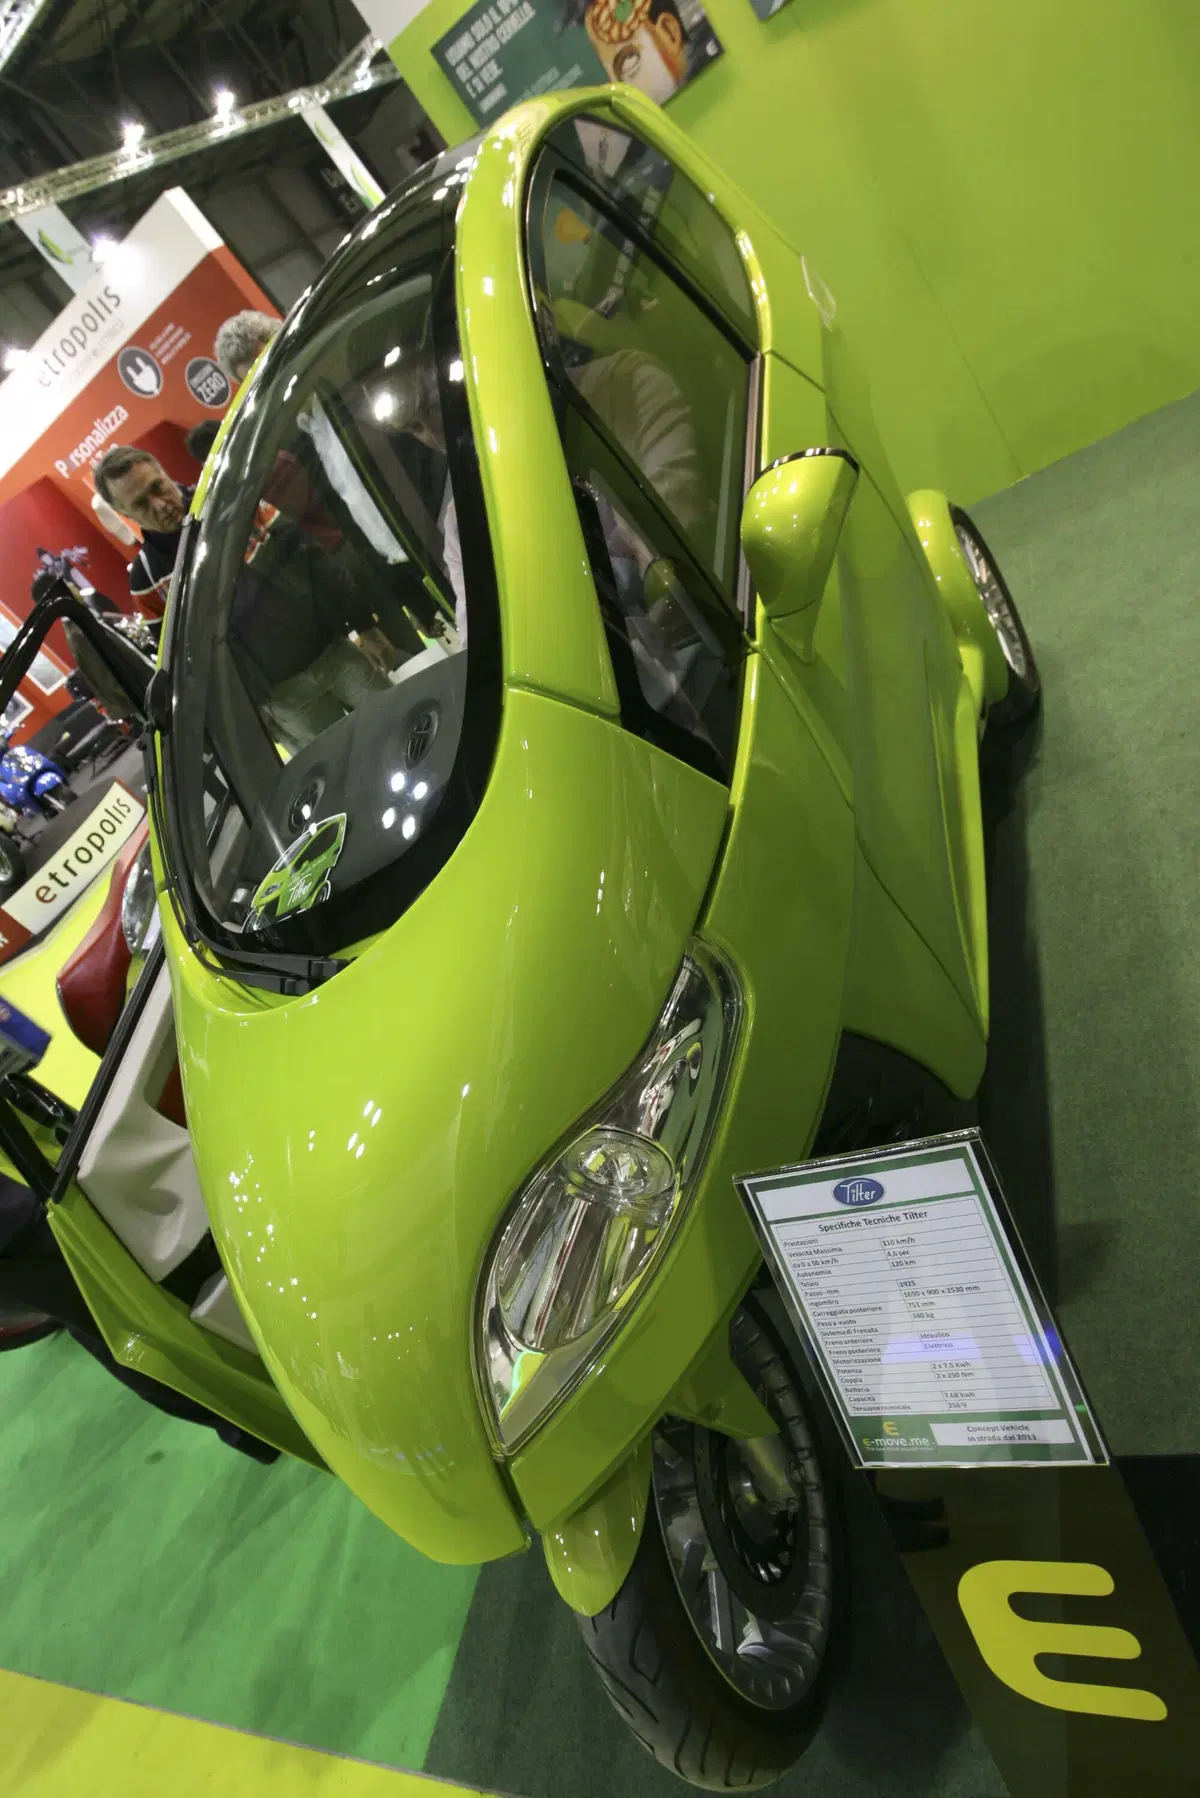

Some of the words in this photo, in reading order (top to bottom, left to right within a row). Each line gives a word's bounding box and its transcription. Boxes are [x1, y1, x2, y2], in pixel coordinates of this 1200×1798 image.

[196, 371, 227, 403] ZERO
[35, 797, 131, 904] etropolis
[840, 1179, 876, 1204] Tilter
[818, 1219, 862, 1233] Specifiche
[863, 1213, 901, 1226] Tecniche
[902, 1210, 929, 1221] Tilter
[783, 1237, 819, 1248] Prestazioni
[813, 1245, 842, 1255] Massima
[882, 1239, 895, 1248] 110
[896, 1237, 916, 1245] km/h
[811, 1259, 820, 1267] 50
[821, 1257, 839, 1266] km/h
[796, 1268, 832, 1279] Autonomia
[891, 1260, 903, 1269] 120
[804, 1289, 823, 1298] Passo
[899, 1280, 916, 1288] 1925
[903, 1290, 920, 1299] 1650
[927, 1288, 939, 1296] 900
[947, 1286, 964, 1294] 2530
[849, 1305, 883, 1316] posteriore
[922, 1300, 936, 1308] mm
[853, 1326, 879, 1335] Frenata
[920, 1331, 951, 1340] Idraulico
[924, 1341, 954, 1350] Elettrico
[966, 1425, 999, 1434] Concept
[1000, 1423, 1031, 1432] Vehicle
[976, 1434, 1002, 1443] strada
[1003, 1434, 1016, 1442] dal
[1016, 1433, 1037, 1442] 2013
